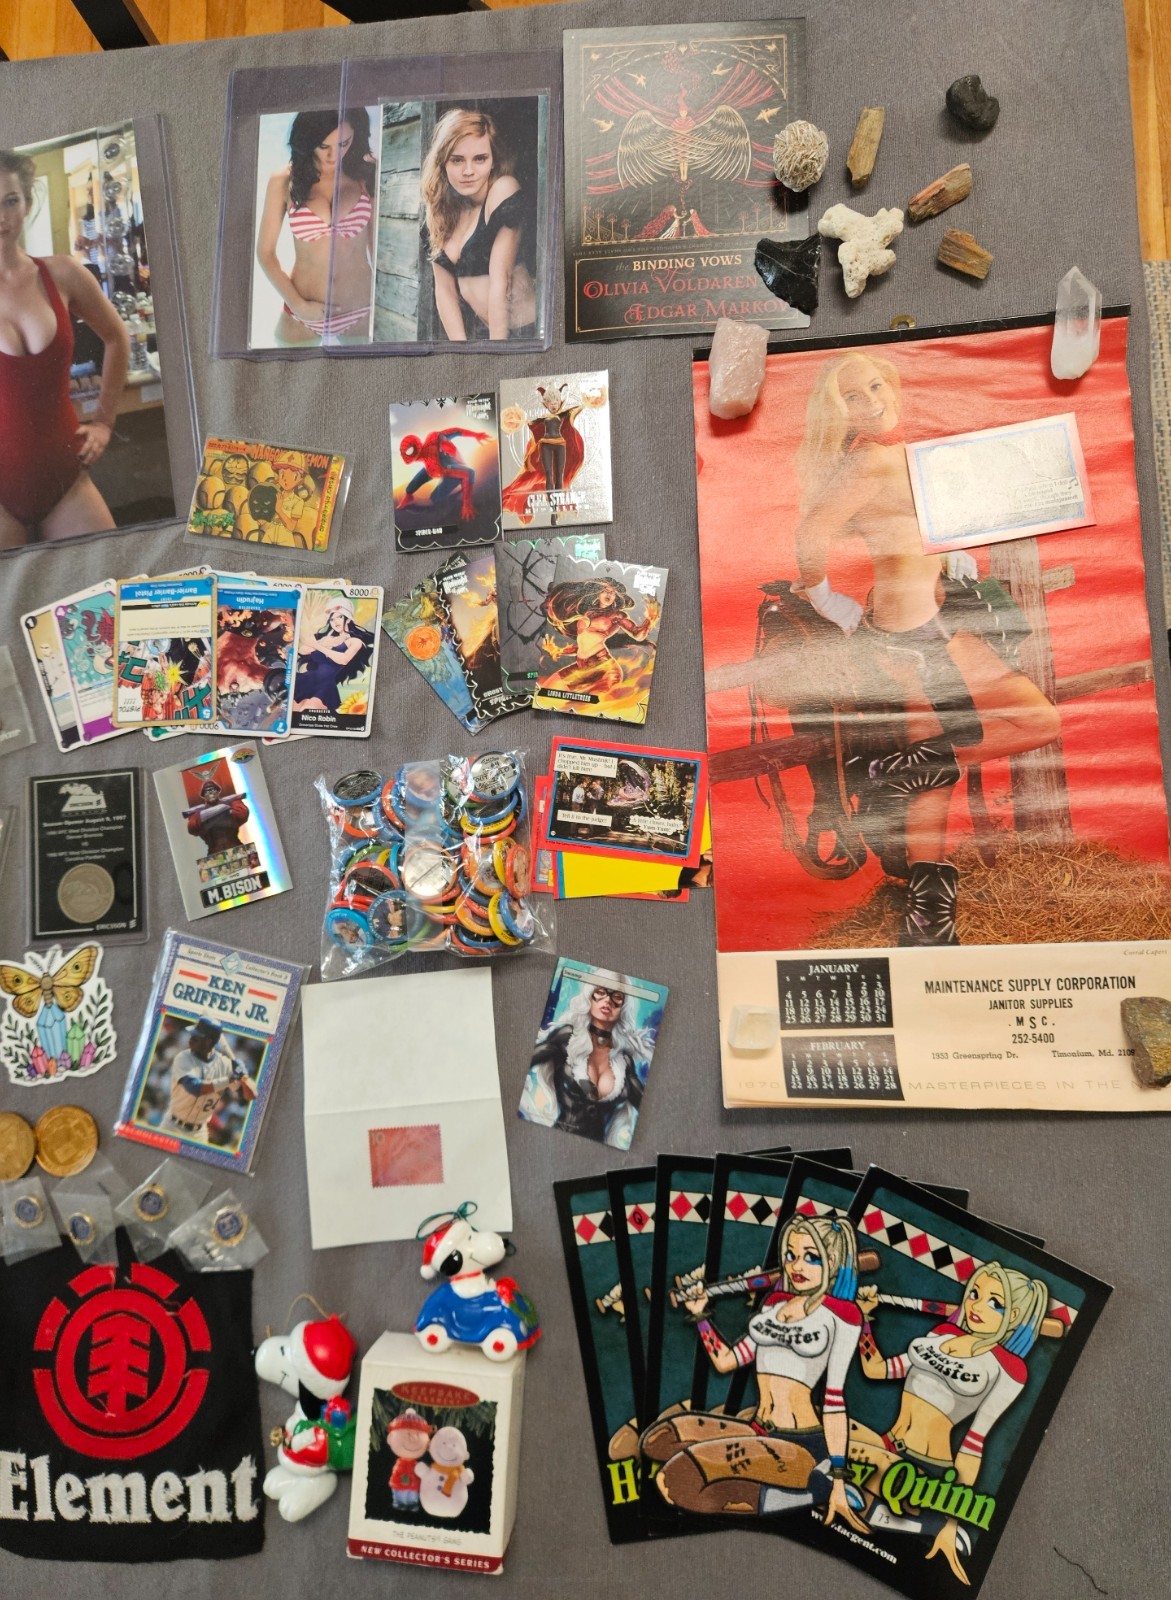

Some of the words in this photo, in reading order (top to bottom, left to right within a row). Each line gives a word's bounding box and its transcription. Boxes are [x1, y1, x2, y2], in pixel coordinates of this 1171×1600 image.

[632, 257, 695, 271] BINDING
[700, 255, 742, 267] VOWS
[154, 587, 198, 596] Barrier-Barrier
[349, 589, 370, 597] 8000
[236, 596, 264, 604] Hajrudin
[202, 708, 211, 719] 5
[275, 721, 285, 732] 7
[207, 889, 223, 904] M.
[222, 875, 263, 899] BISON
[808, 964, 859, 976] JANUARY
[208, 975, 246, 996] KEN
[846, 982, 851, 990] 1
[861, 982, 867, 990] 2
[924, 980, 1004, 994] MAINTENANCE
[1009, 978, 1051, 992] SUPPLY
[1057, 976, 1136, 991] CORPORATION
[786, 991, 792, 999] 4
[816, 990, 822, 998] 6
[831, 990, 837, 998] 7
[861, 990, 868, 998] 9
[874, 990, 885, 998] 10
[172, 982, 241, 1017] GRIFFEY,
[245, 1003, 270, 1024] JR.
[785, 999, 793, 1007] 11
[800, 999, 810, 1007] 12
[830, 998, 839, 1006] 14
[845, 998, 855, 1006] 15
[860, 998, 870, 1006] 16
[989, 999, 1025, 1010] JANITOR
[1030, 998, 1073, 1009] SUPPLIES
[785, 1007, 795, 1015] 18
[800, 1007, 810, 1015] 19
[845, 1006, 857, 1014] 22
[860, 1006, 871, 1014] 23
[875, 1005, 887, 1014] 24
[785, 1015, 797, 1024] 25
[800, 1015, 811, 1024] 26
[815, 1015, 826, 1023] 27
[830, 1014, 842, 1023] 28
[845, 1014, 857, 1023] 29
[860, 1014, 872, 1023] 30
[876, 1014, 887, 1023] 31
[1012, 1033, 1054, 1044] 252-5400
[810, 1041, 866, 1051] FEBRUARY
[953, 1052, 1003, 1061] Greenspring
[1006, 1051, 1018, 1059] Dr.
[1051, 1050, 1094, 1058] Timonium,
[1098, 1049, 1114, 1057] Md.
[792, 1060, 797, 1068] 1
[807, 1060, 813, 1068] 2
[853, 1059, 859, 1067] 5
[868, 1059, 875, 1067] 6
[881, 1058, 889, 1066] 7
[792, 1067, 799, 1075] 8
[807, 1067, 814, 1075] 9
[821, 1067, 832, 1075] 10
[852, 1067, 862, 1075] 12
[868, 1067, 878, 1075] 13
[908, 1081, 1047, 1091] MASTERPIECES
[1056, 1081, 1074, 1090] IN
[1085, 1080, 1120, 1089] THE
[632, 1209, 644, 1226] Q
[763, 1328, 821, 1346] Monster
[927, 1344, 965, 1370] Daddy's
[922, 1352, 981, 1384] Monster
[0, 1450, 259, 1524] Element
[881, 1461, 997, 1531] Quinn
[811, 1510, 898, 1564] w.tacgent.com
[361, 1545, 381, 1554] NEW
[384, 1548, 450, 1564] COLLECTOR'S
[454, 1558, 490, 1569] SERIES
